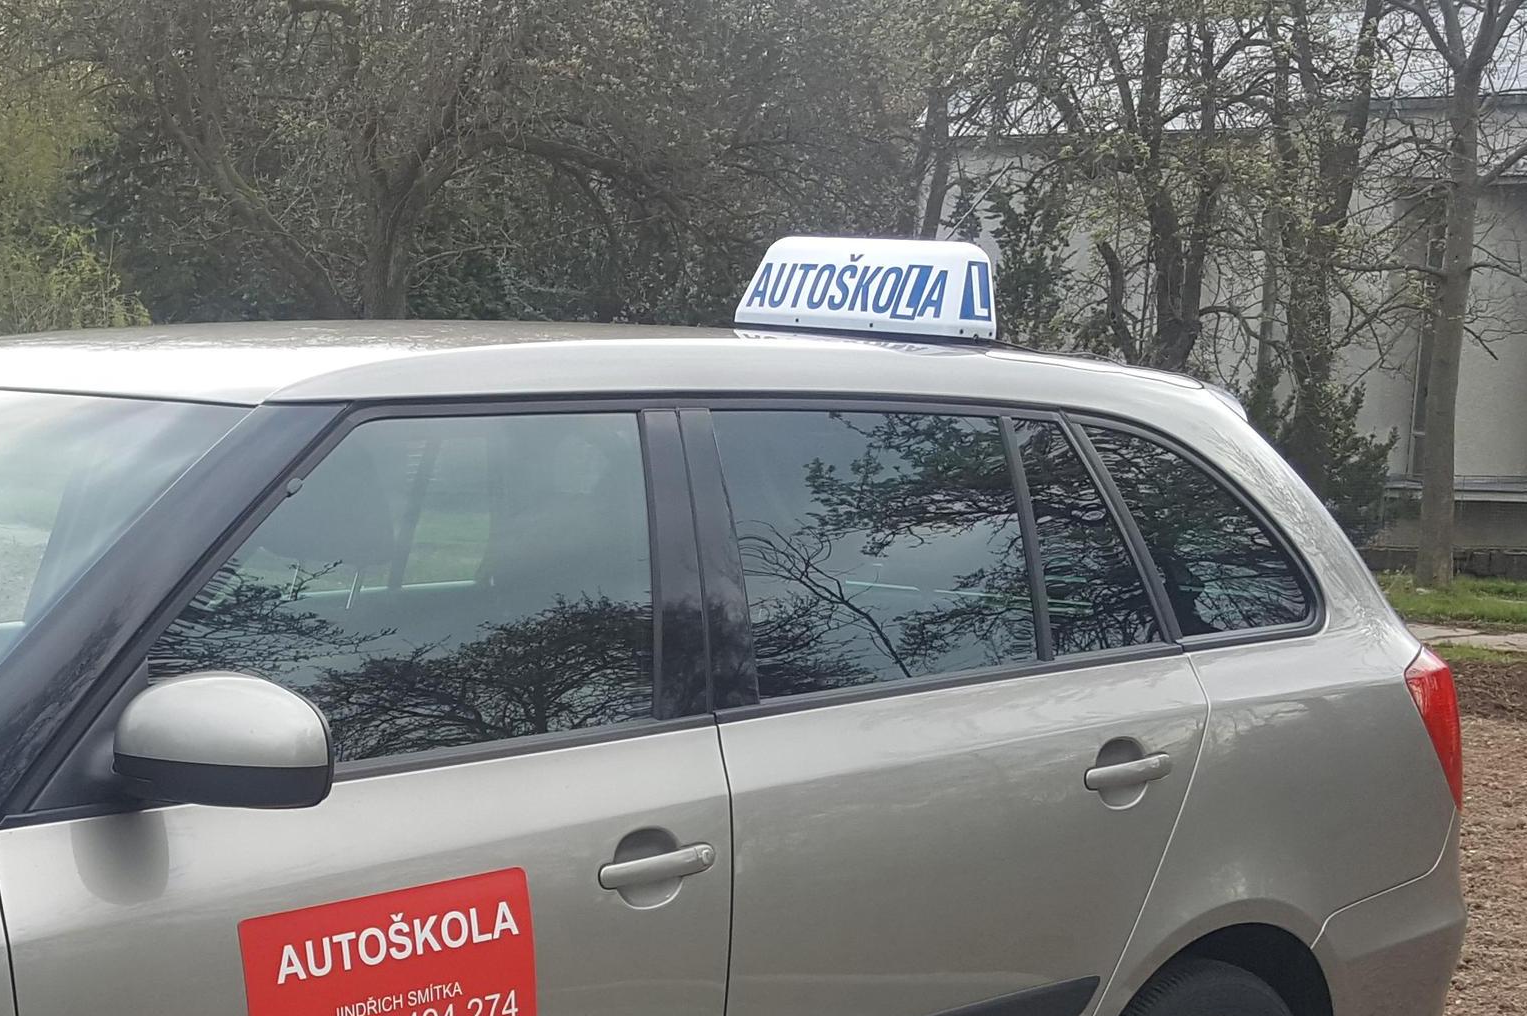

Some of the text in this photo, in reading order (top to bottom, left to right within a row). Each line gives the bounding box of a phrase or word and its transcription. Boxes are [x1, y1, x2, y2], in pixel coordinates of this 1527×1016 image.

[747, 254, 949, 321] AUTOŠKOLA
[277, 901, 519, 984] AUTOŠKOLA
[407, 981, 463, 1007] SMÍTKA
